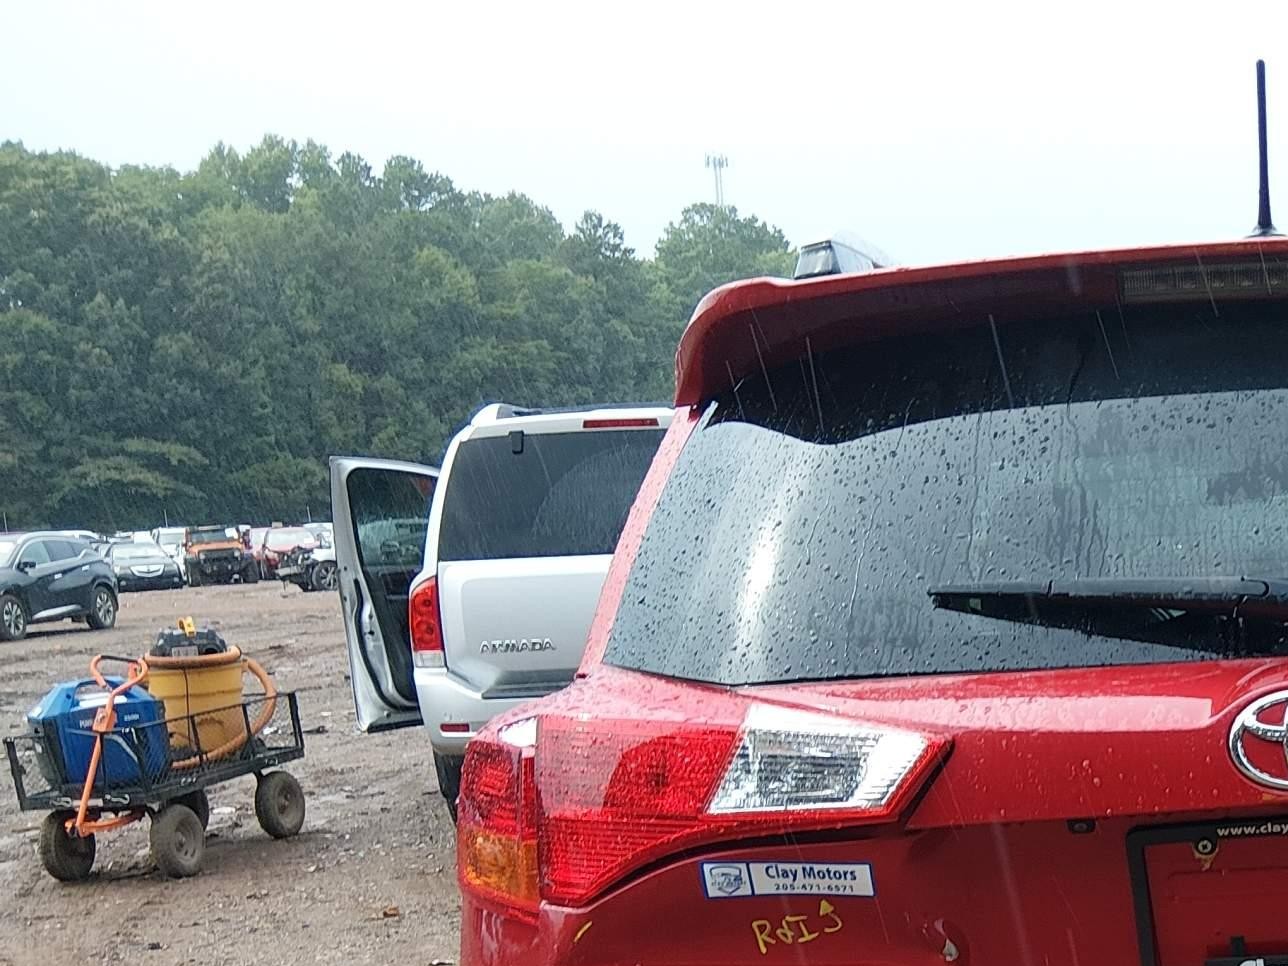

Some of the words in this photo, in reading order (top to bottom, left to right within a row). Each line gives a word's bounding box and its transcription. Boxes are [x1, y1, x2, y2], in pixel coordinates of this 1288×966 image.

[480, 638, 555, 654] ARMADA
[765, 865, 798, 882] Clay
[802, 865, 857, 881] Motors
